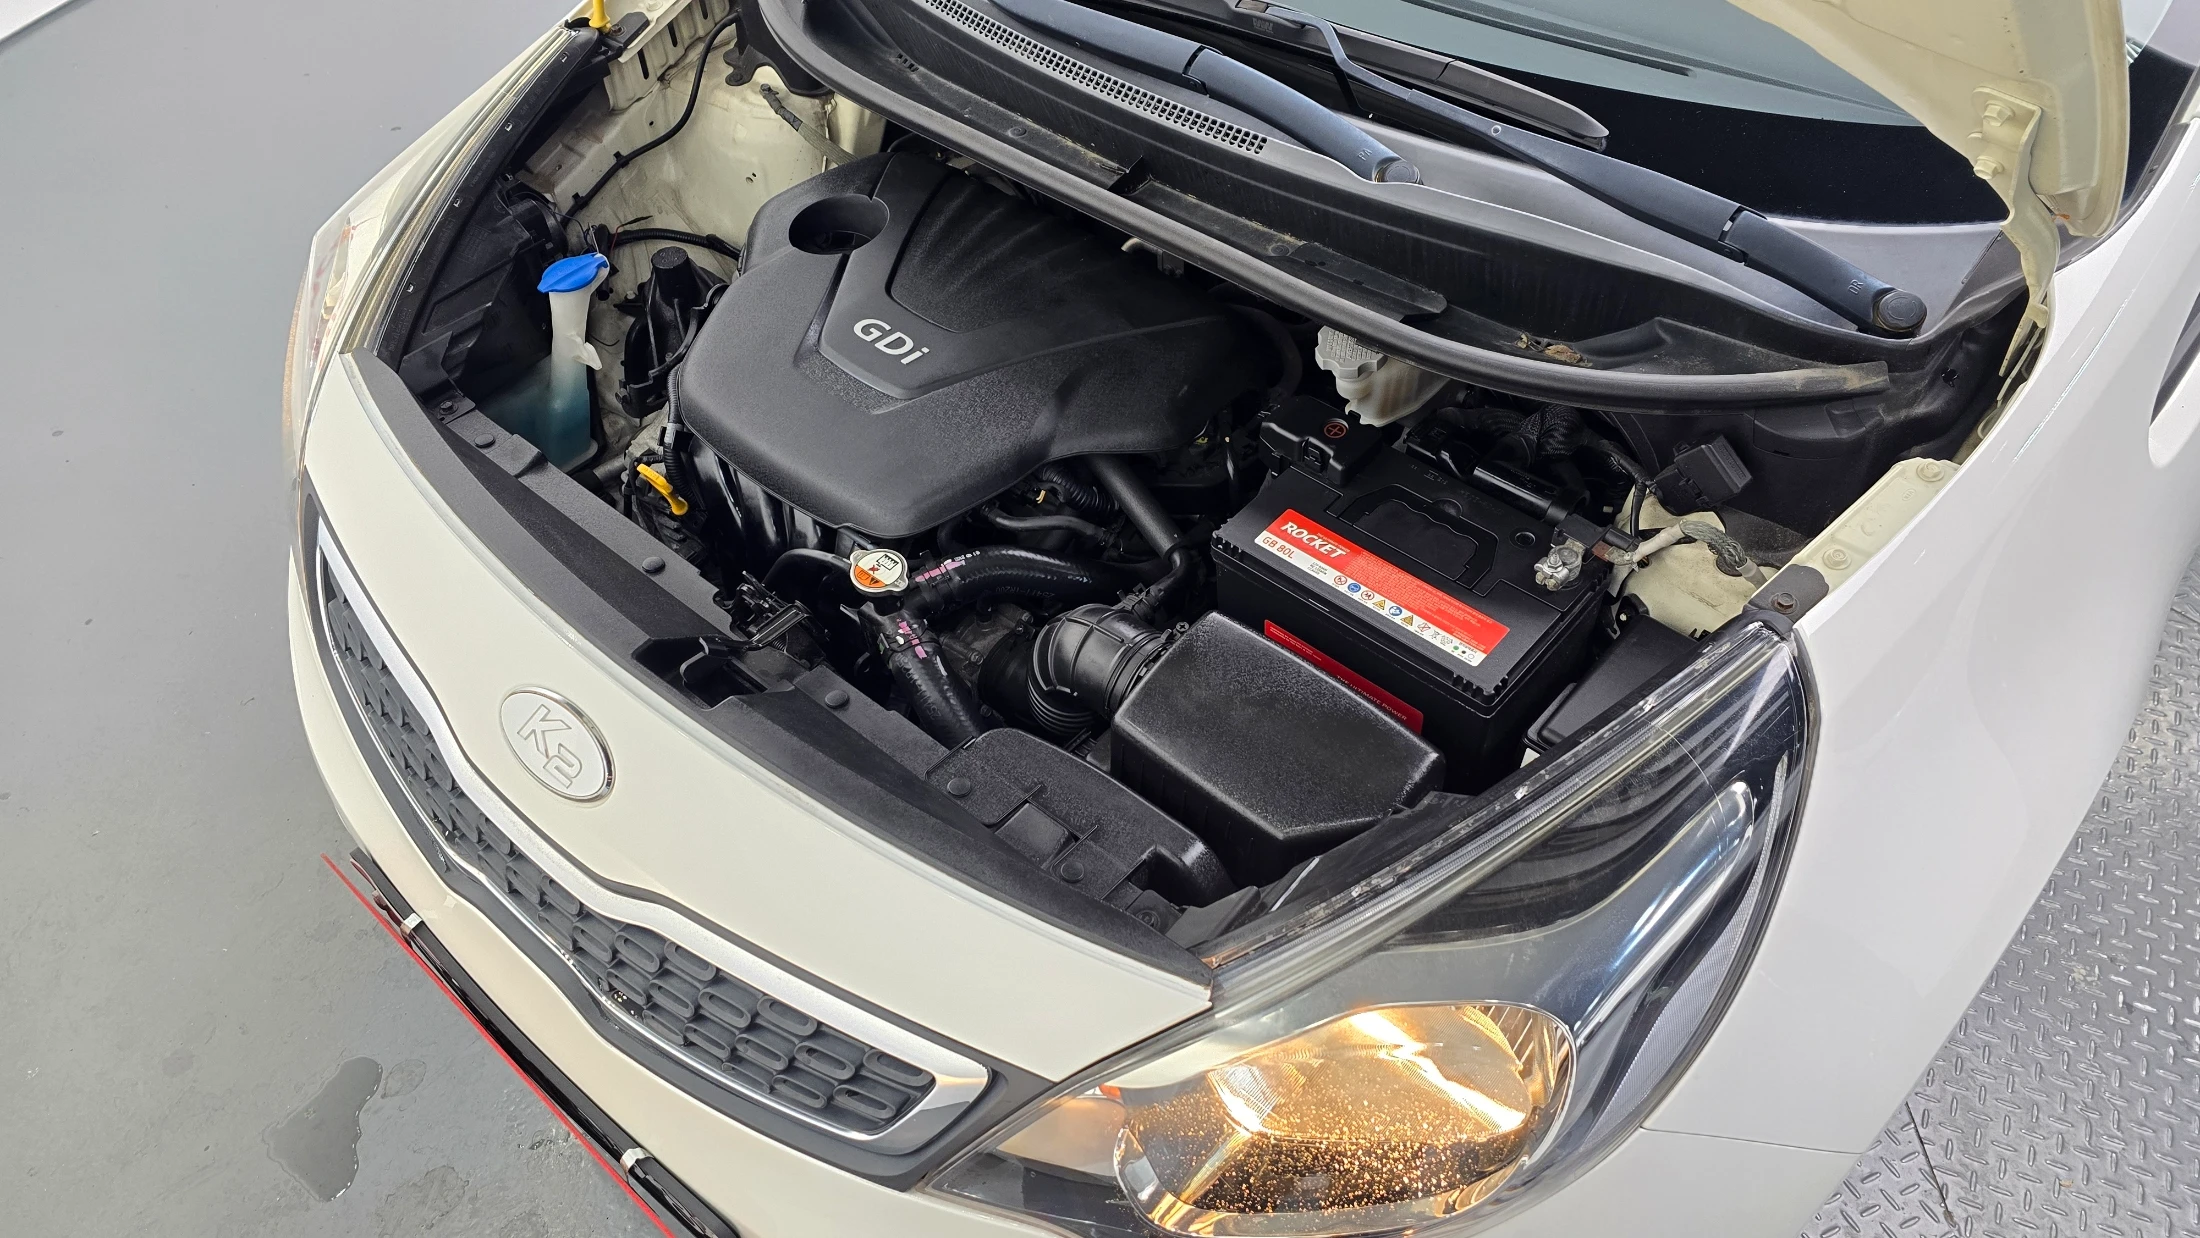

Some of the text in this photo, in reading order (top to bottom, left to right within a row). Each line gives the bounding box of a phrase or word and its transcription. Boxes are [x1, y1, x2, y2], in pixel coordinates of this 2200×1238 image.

[853, 318, 930, 365] GDi
[1262, 536, 1296, 559] GB 80L
[1280, 521, 1347, 558] ROCKET
[1381, 703, 1408, 720] POWER
[516, 703, 583, 789] K2
